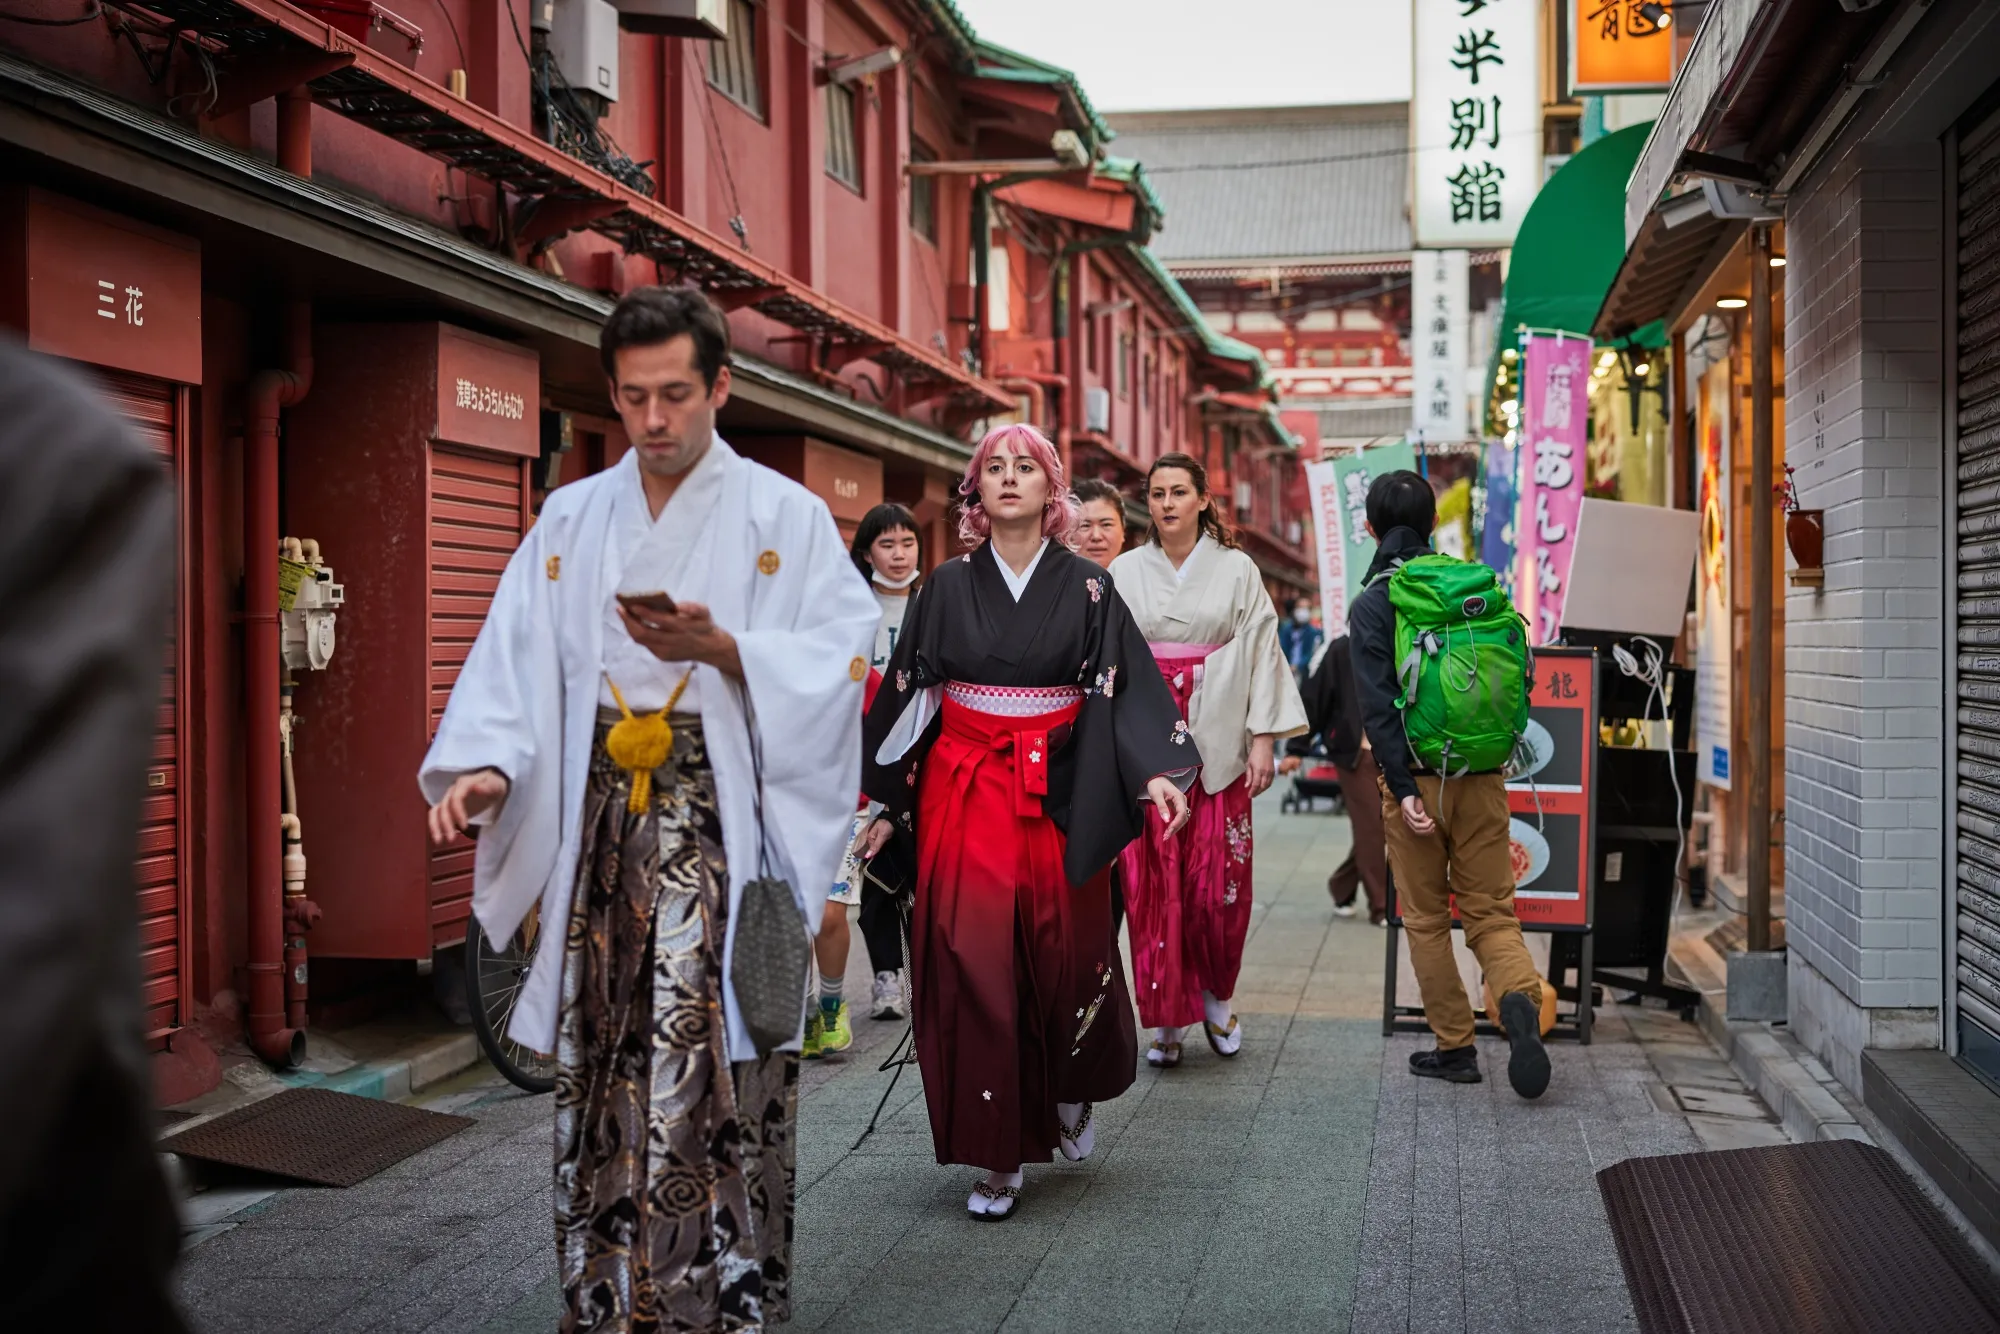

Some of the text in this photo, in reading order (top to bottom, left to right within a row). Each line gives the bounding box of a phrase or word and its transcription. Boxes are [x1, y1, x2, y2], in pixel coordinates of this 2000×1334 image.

[97, 280, 144, 327] 三花
[456, 377, 525, 420] 浅草ちょうちんもなか
[1545, 671, 1578, 699] 龍
